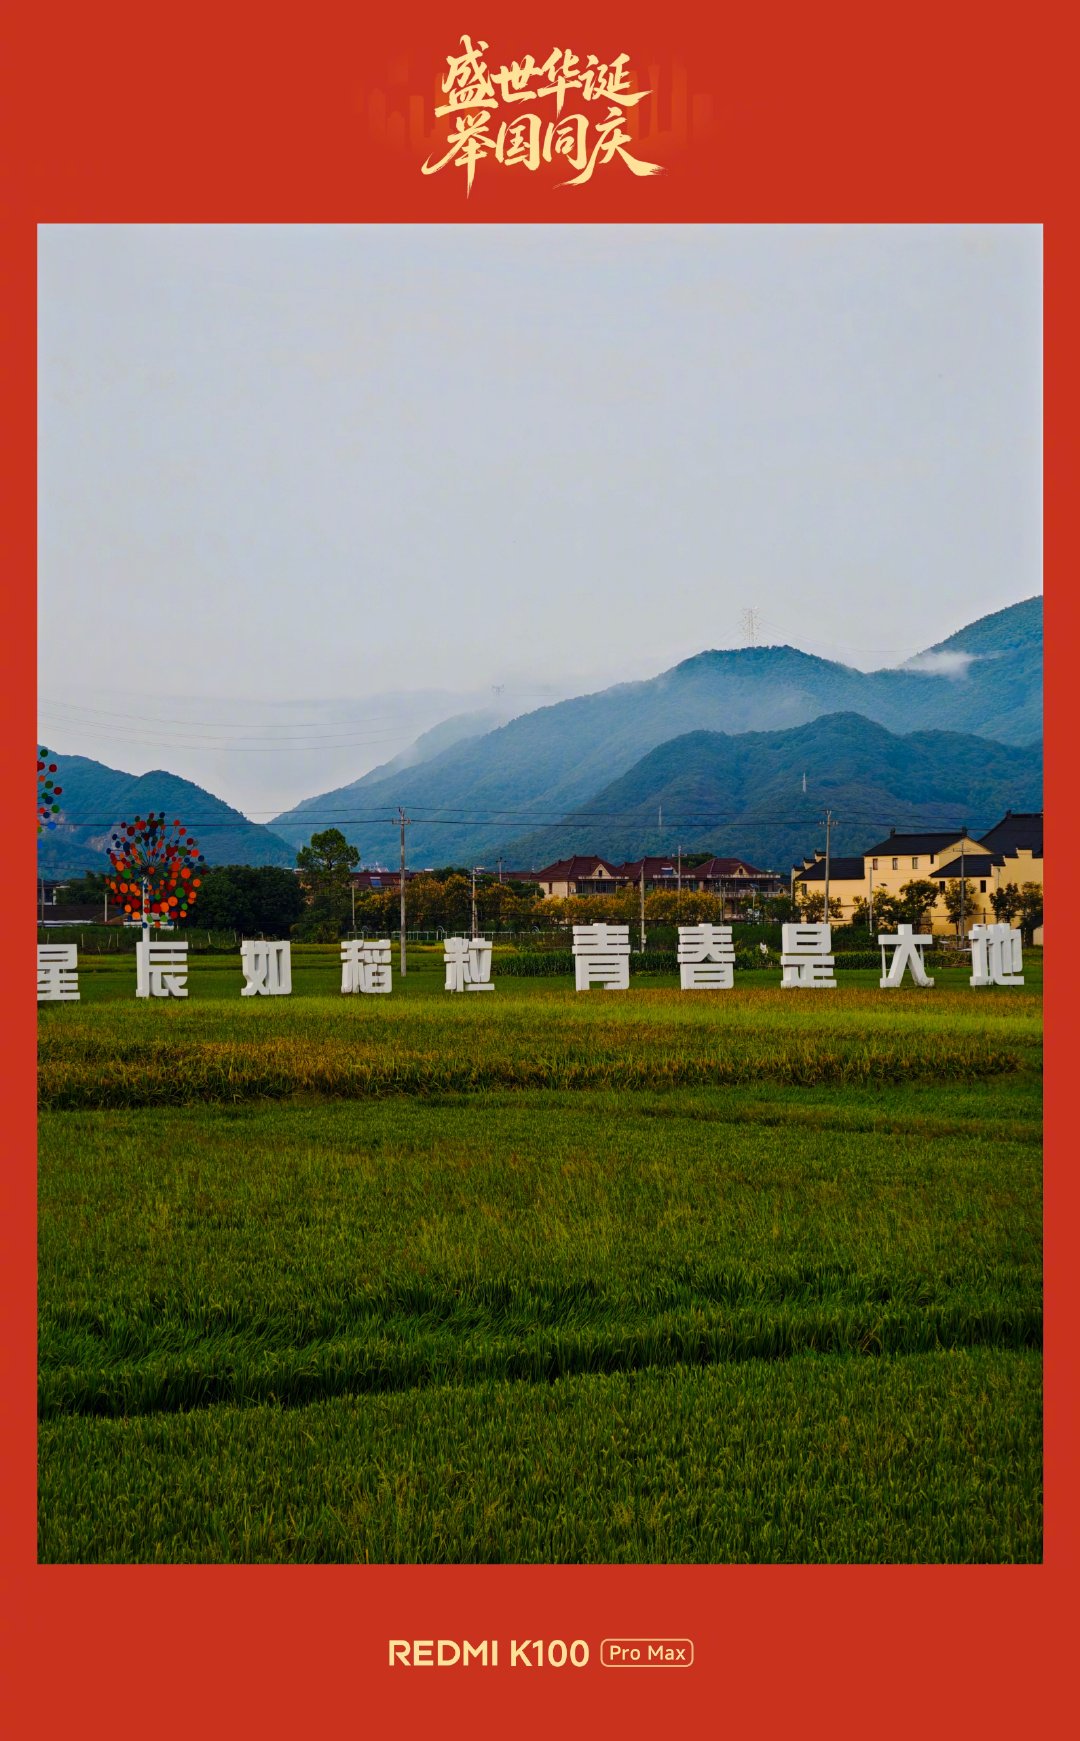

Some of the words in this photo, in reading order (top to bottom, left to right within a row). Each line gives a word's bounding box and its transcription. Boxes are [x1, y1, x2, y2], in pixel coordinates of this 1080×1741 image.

[37, 936, 494, 1001] 星辰如稻粒
[571, 921, 1025, 991] 青春是大地
